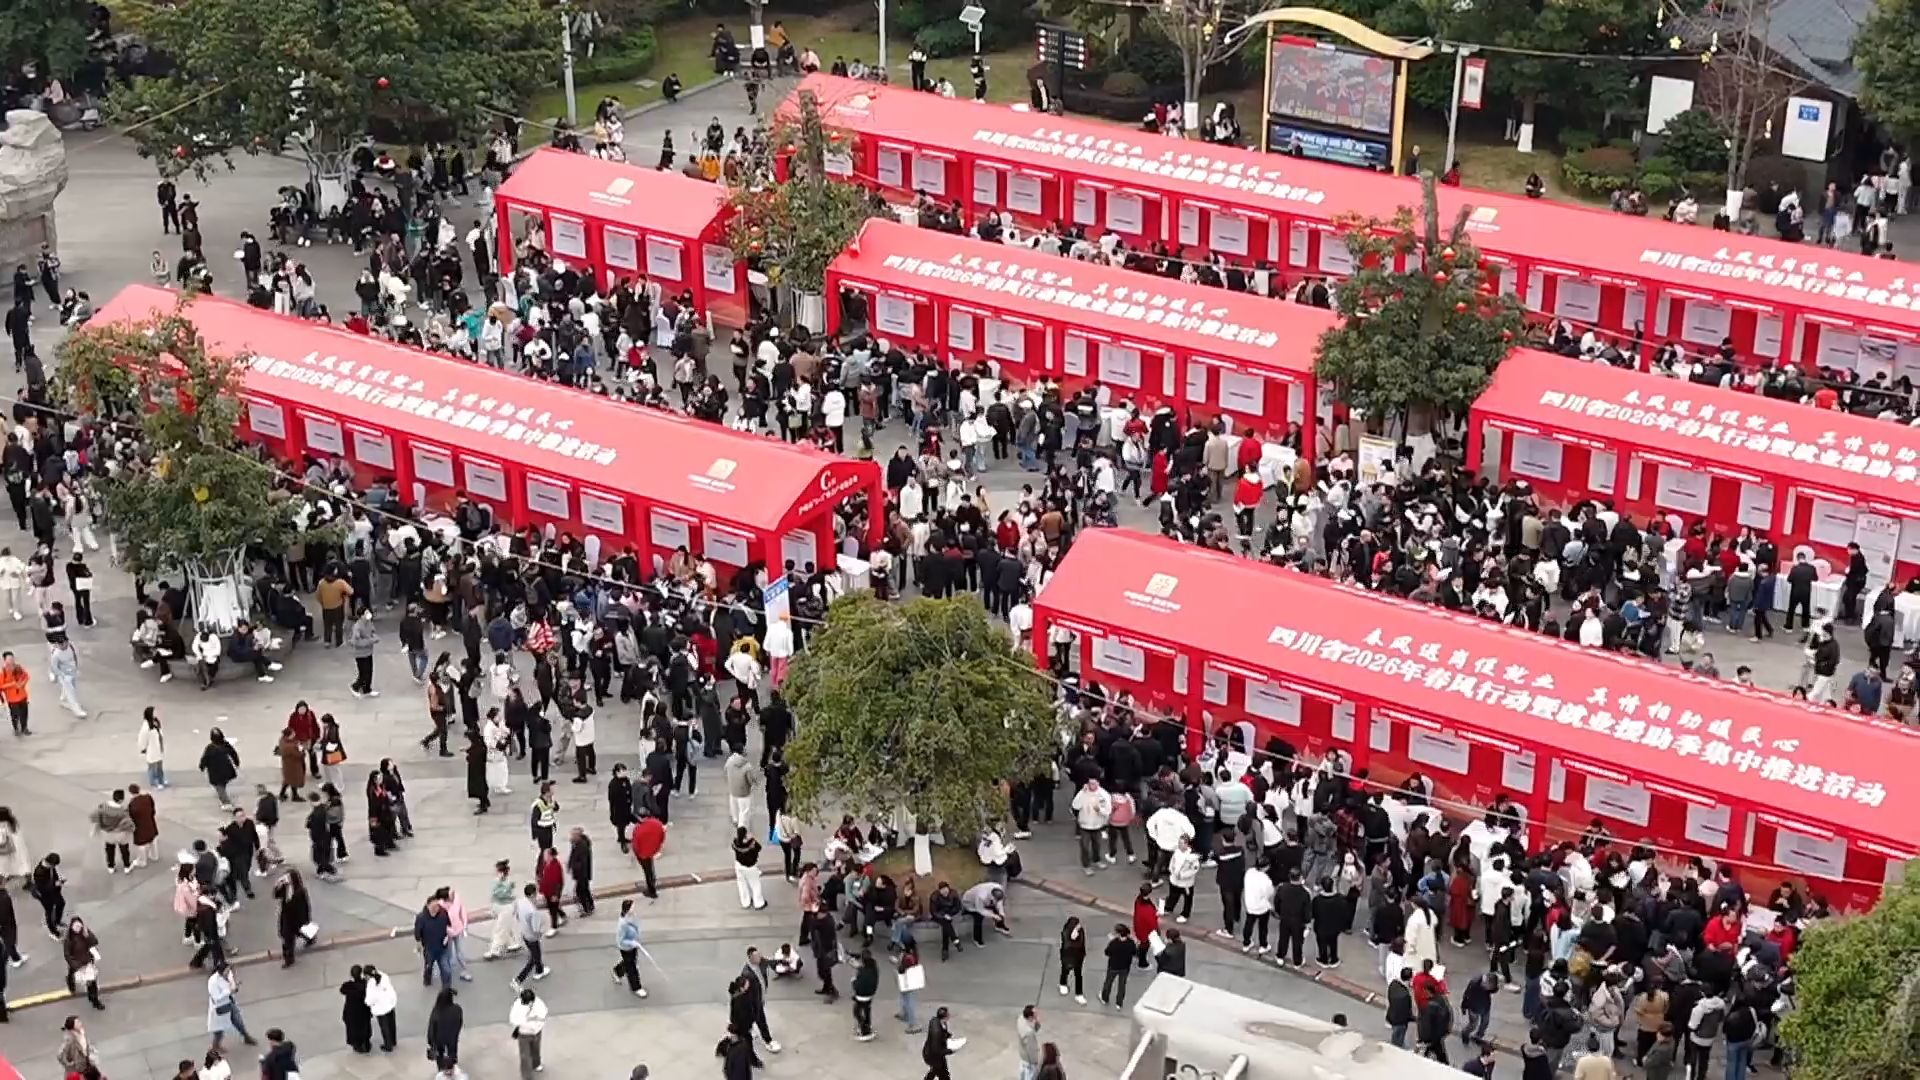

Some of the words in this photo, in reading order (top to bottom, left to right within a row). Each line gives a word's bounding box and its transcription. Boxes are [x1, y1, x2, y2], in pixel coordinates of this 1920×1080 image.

[1622, 389, 1789, 434] 春风送岗促就业
[1267, 625, 1887, 808] 四川省2026年春风行动暨就业援助季集中推进活动
[1363, 627, 1555, 690] 春风送岗促就业
[1586, 686, 1800, 752] 真情相助暖民心
